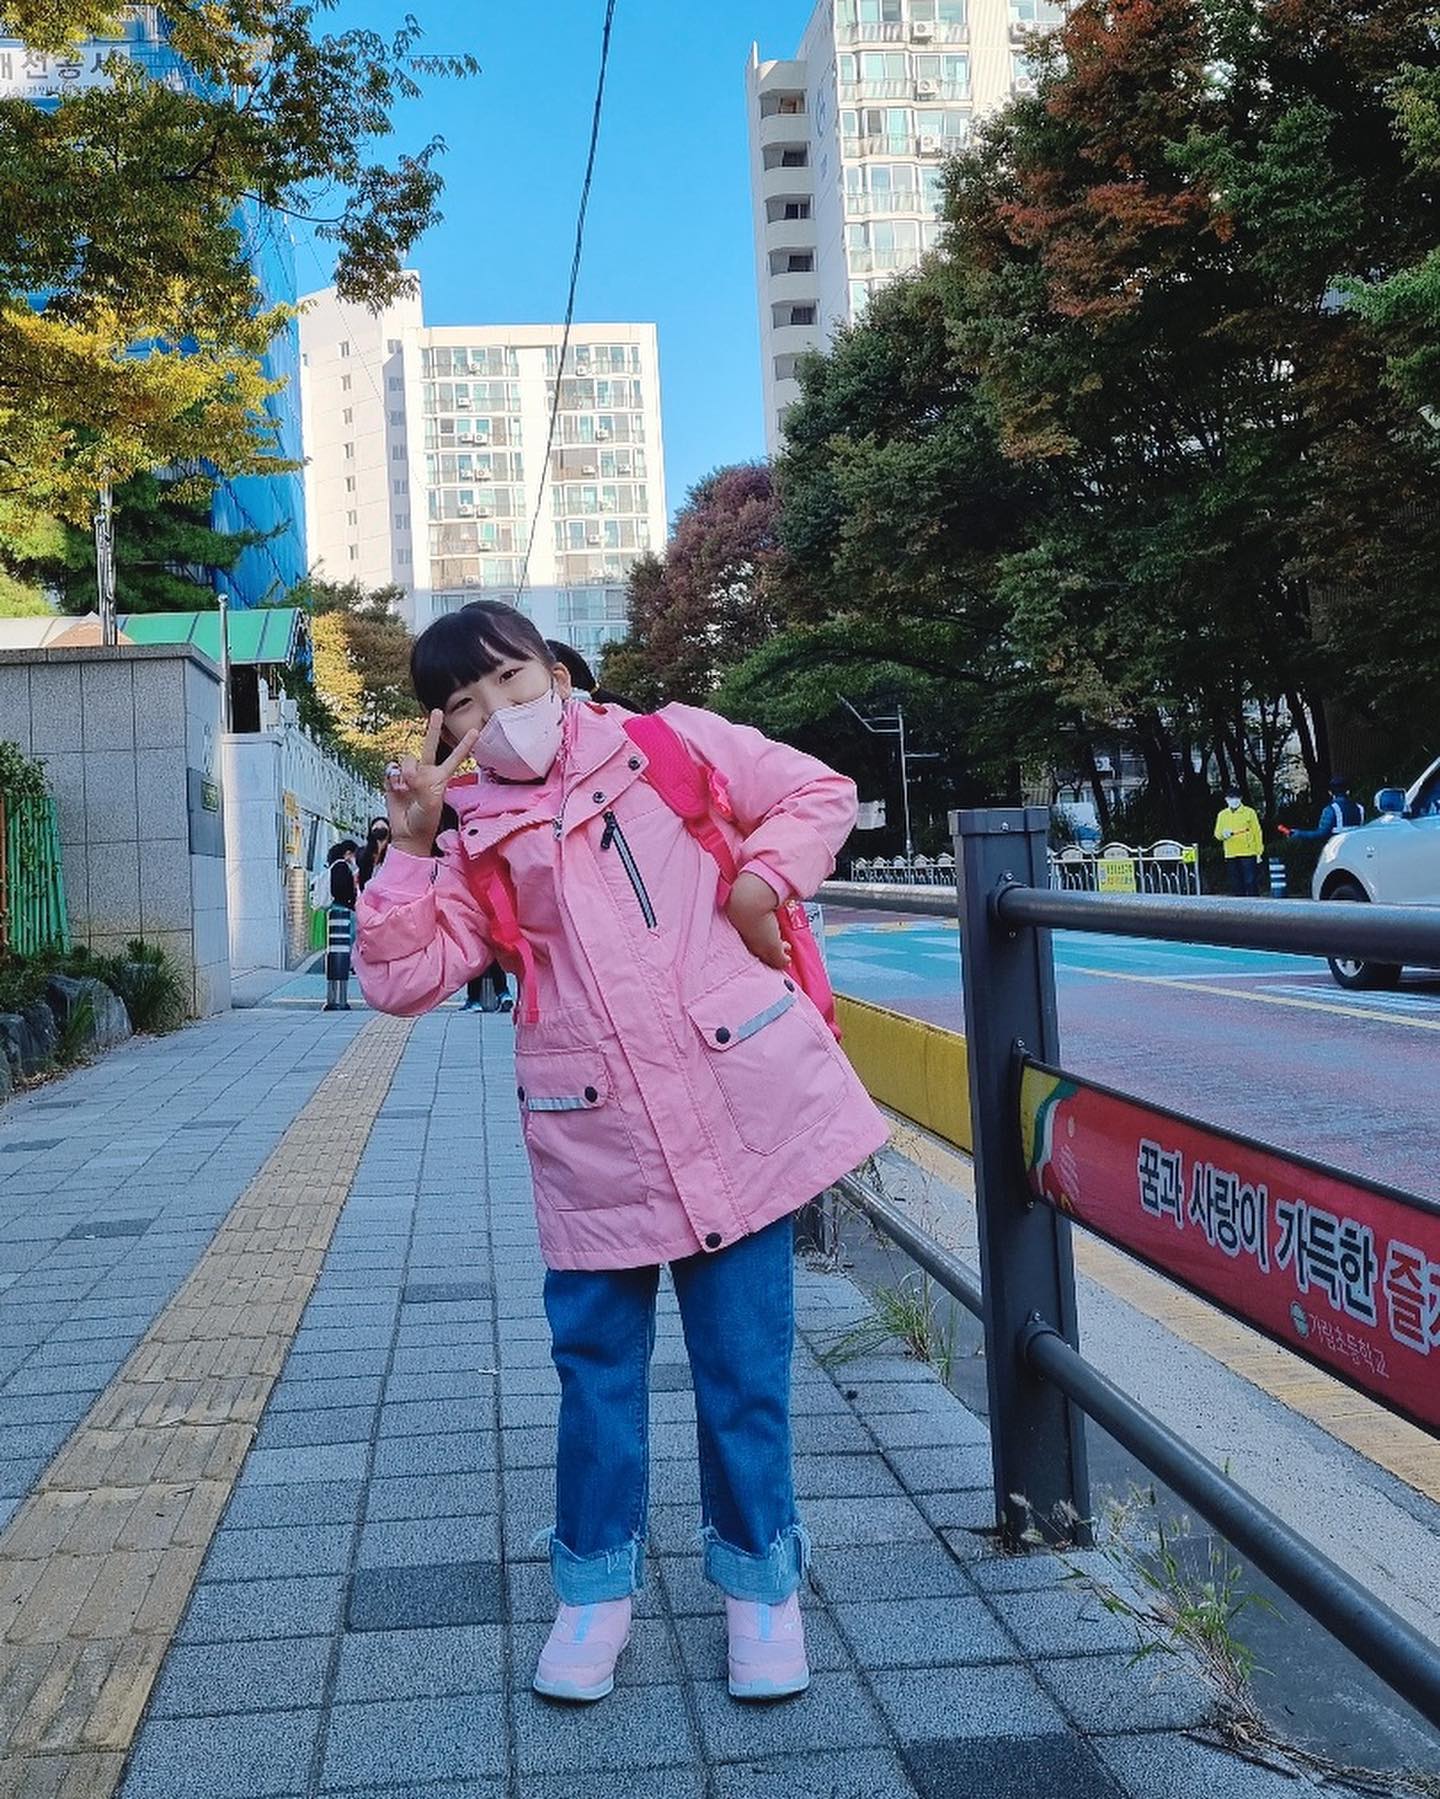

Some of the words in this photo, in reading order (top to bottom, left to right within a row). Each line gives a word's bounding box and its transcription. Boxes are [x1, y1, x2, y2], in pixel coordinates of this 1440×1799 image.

[1138, 1138, 1184, 1229] 꿈과
[1189, 1163, 1269, 1272] 사랑이
[1276, 1200, 1377, 1328] 가득한
